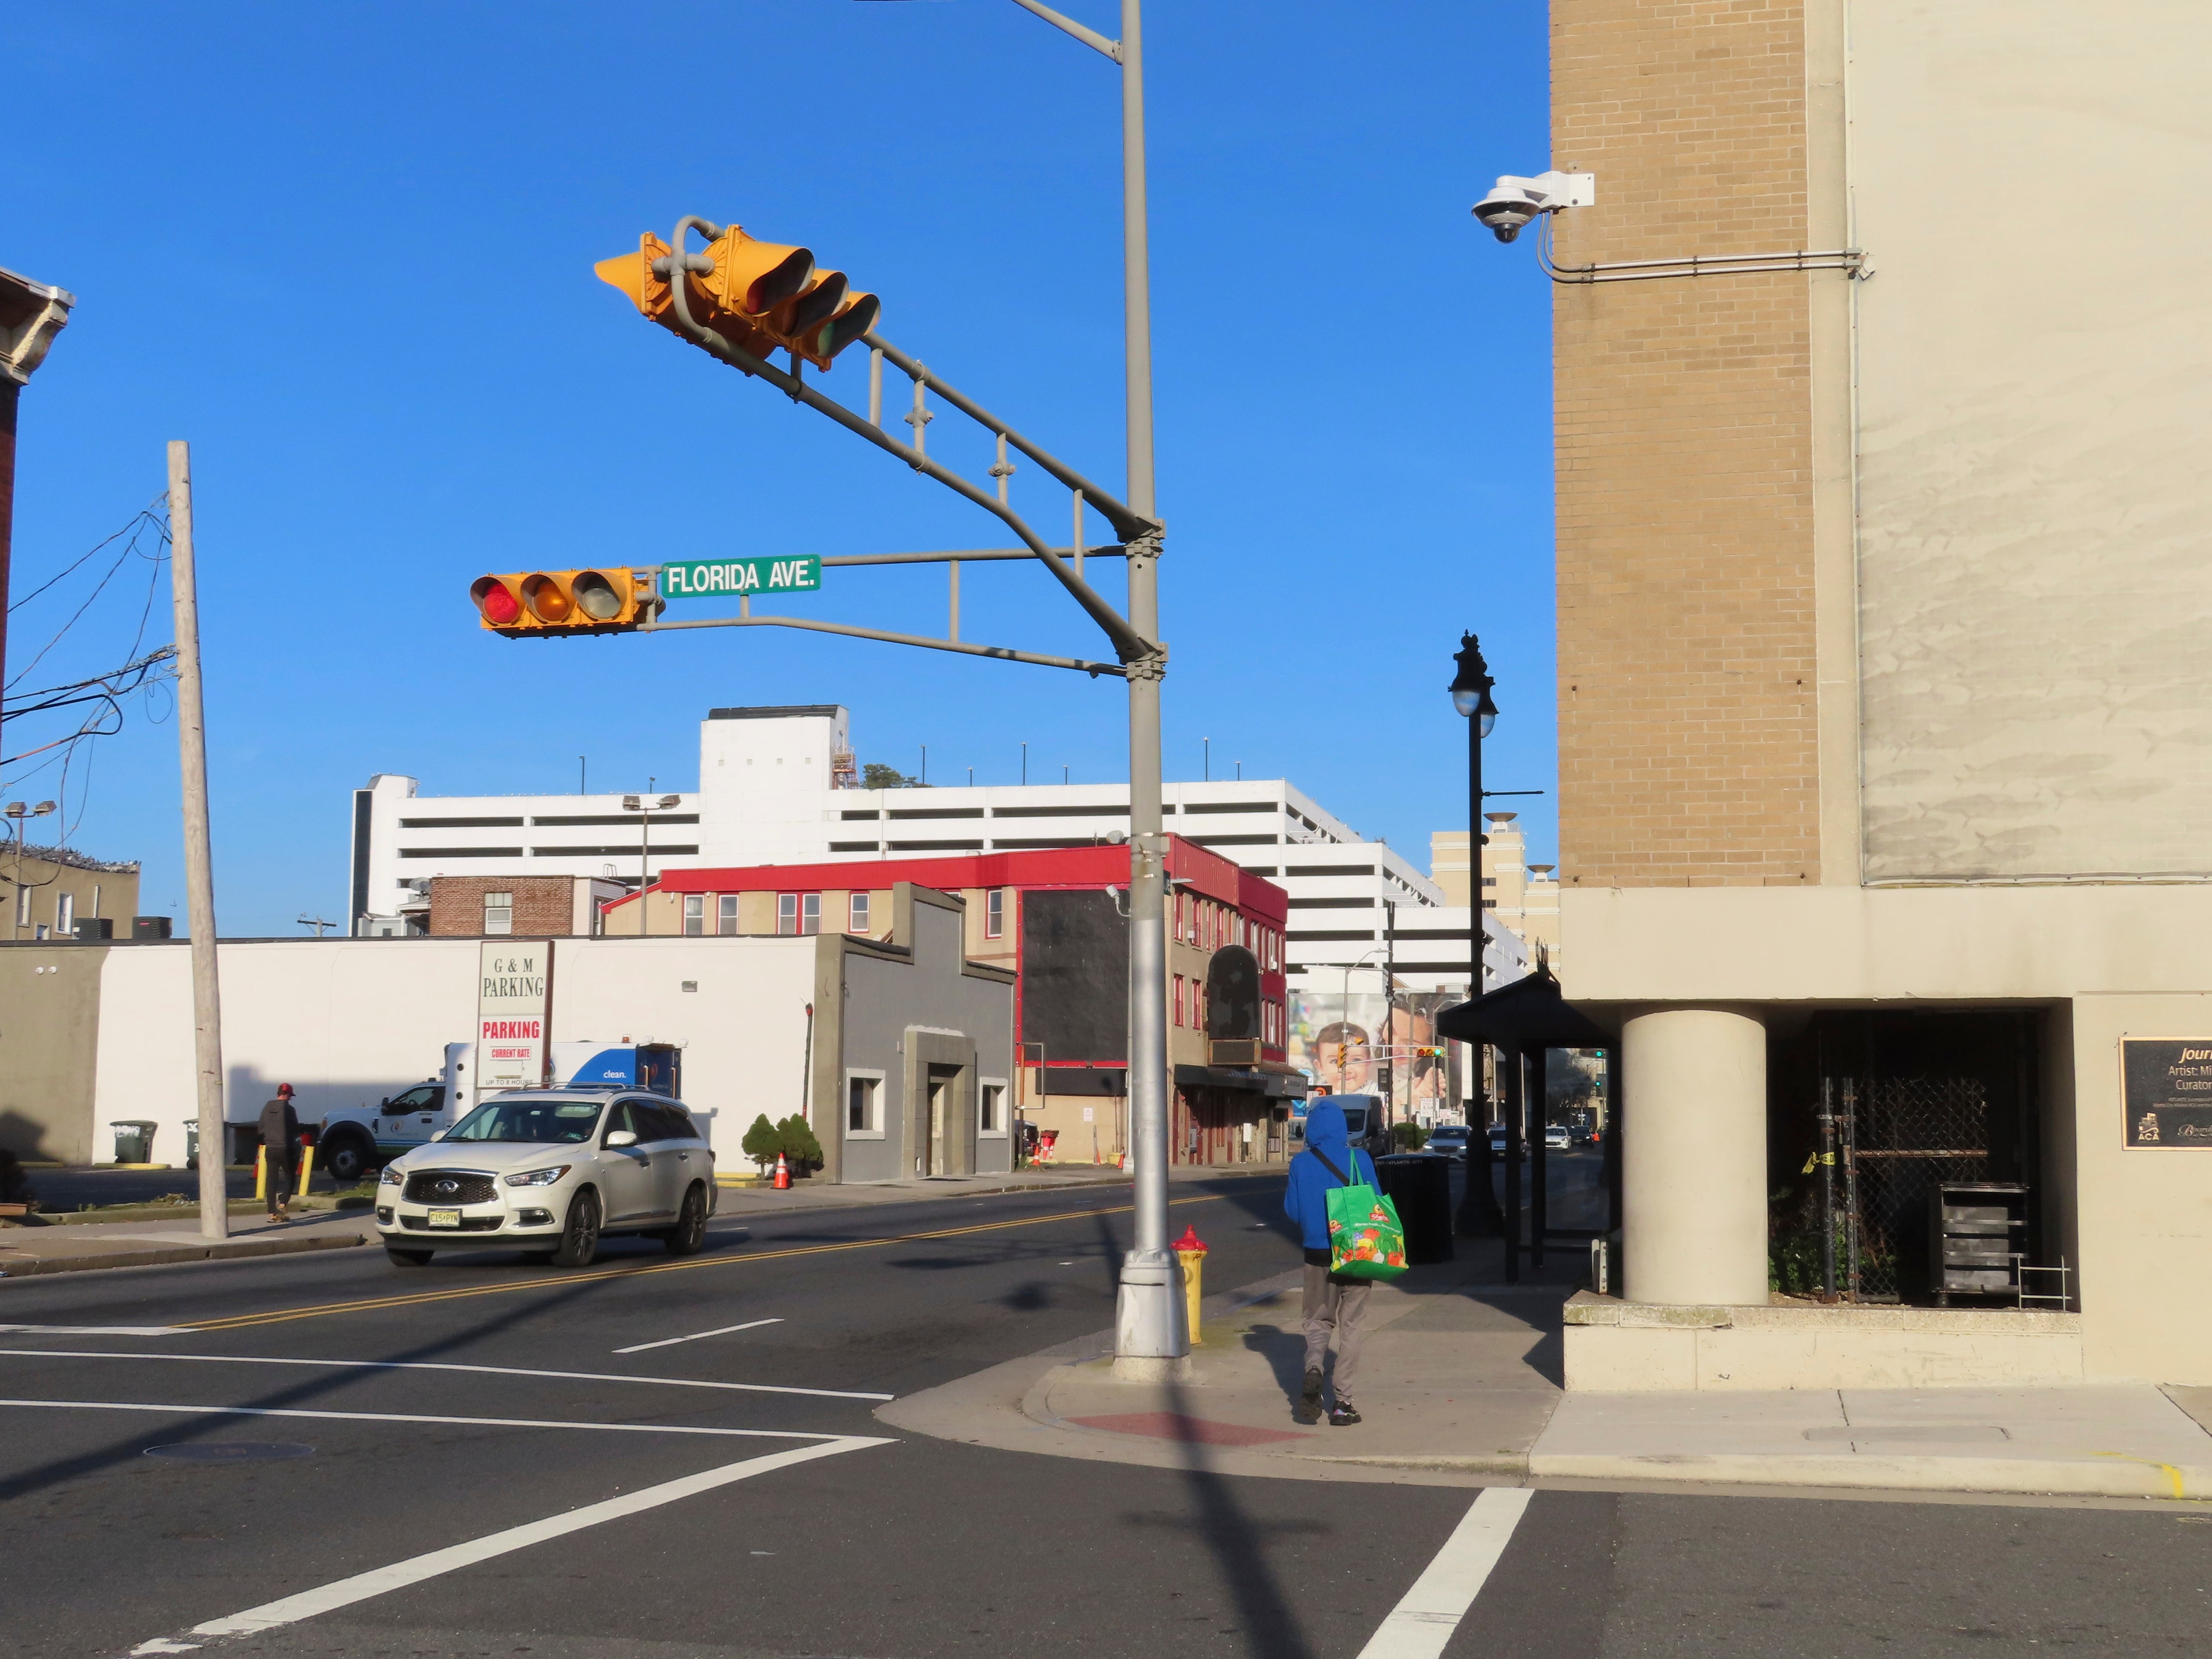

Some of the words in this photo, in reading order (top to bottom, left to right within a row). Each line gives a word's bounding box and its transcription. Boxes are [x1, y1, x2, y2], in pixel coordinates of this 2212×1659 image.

[668, 563, 760, 593] FLORIDA
[769, 560, 815, 588] AVE.
[494, 958, 503, 973] G
[508, 958, 518, 972] &
[523, 958, 533, 972] M
[483, 977, 544, 997] PARKING
[483, 1021, 540, 1039] PARKING
[492, 1049, 516, 1058] CURRENT
[517, 1049, 530, 1058] RATE
[603, 1070, 627, 1078] clean.
